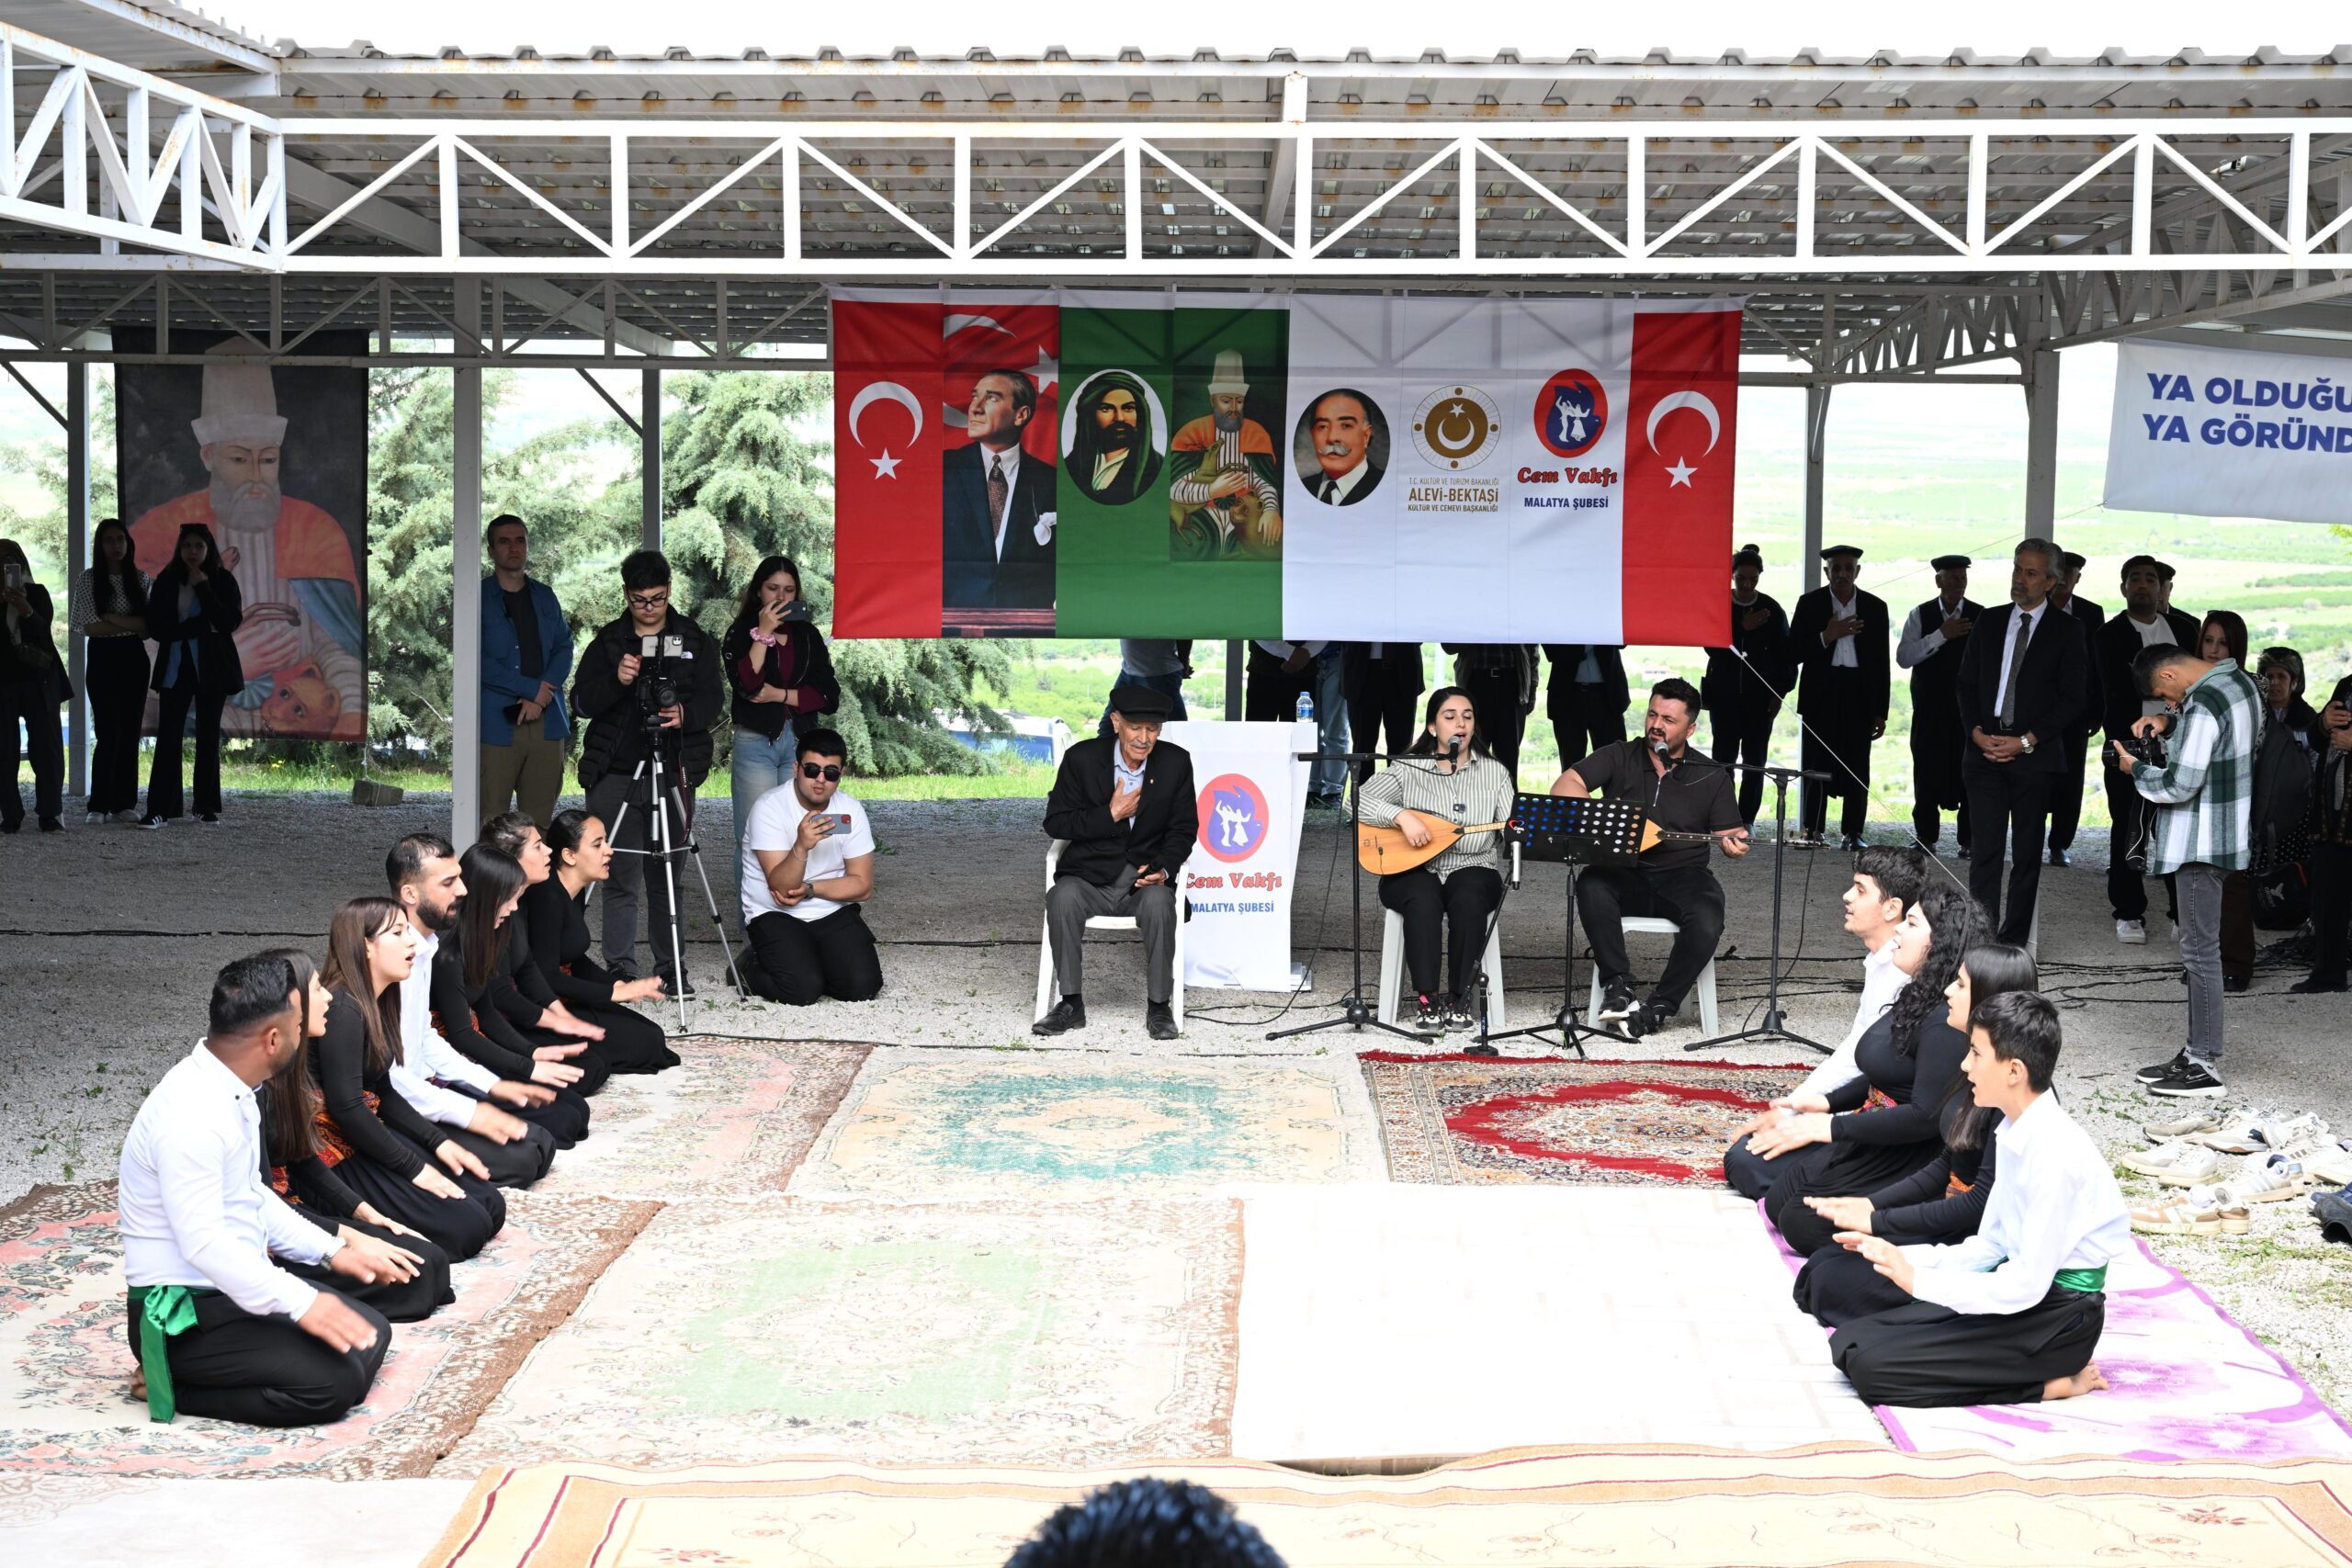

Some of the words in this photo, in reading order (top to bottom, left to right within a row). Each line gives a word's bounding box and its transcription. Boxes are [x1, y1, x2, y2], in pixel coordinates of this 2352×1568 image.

[2146, 372, 2195, 402] YA
[2142, 413, 2190, 443] YA
[1517, 467, 1559, 483] Cem
[1565, 467, 1617, 488] Vakfı
[1463, 504, 1498, 513] BAŞKANLIĞI
[1524, 497, 1570, 508] MALATYA
[1573, 496, 1609, 511] ŞUBESİ
[1228, 872, 1283, 892] Vakfı
[1190, 902, 1235, 913] MALATYA
[1238, 900, 1274, 915] ŞUBESİ
